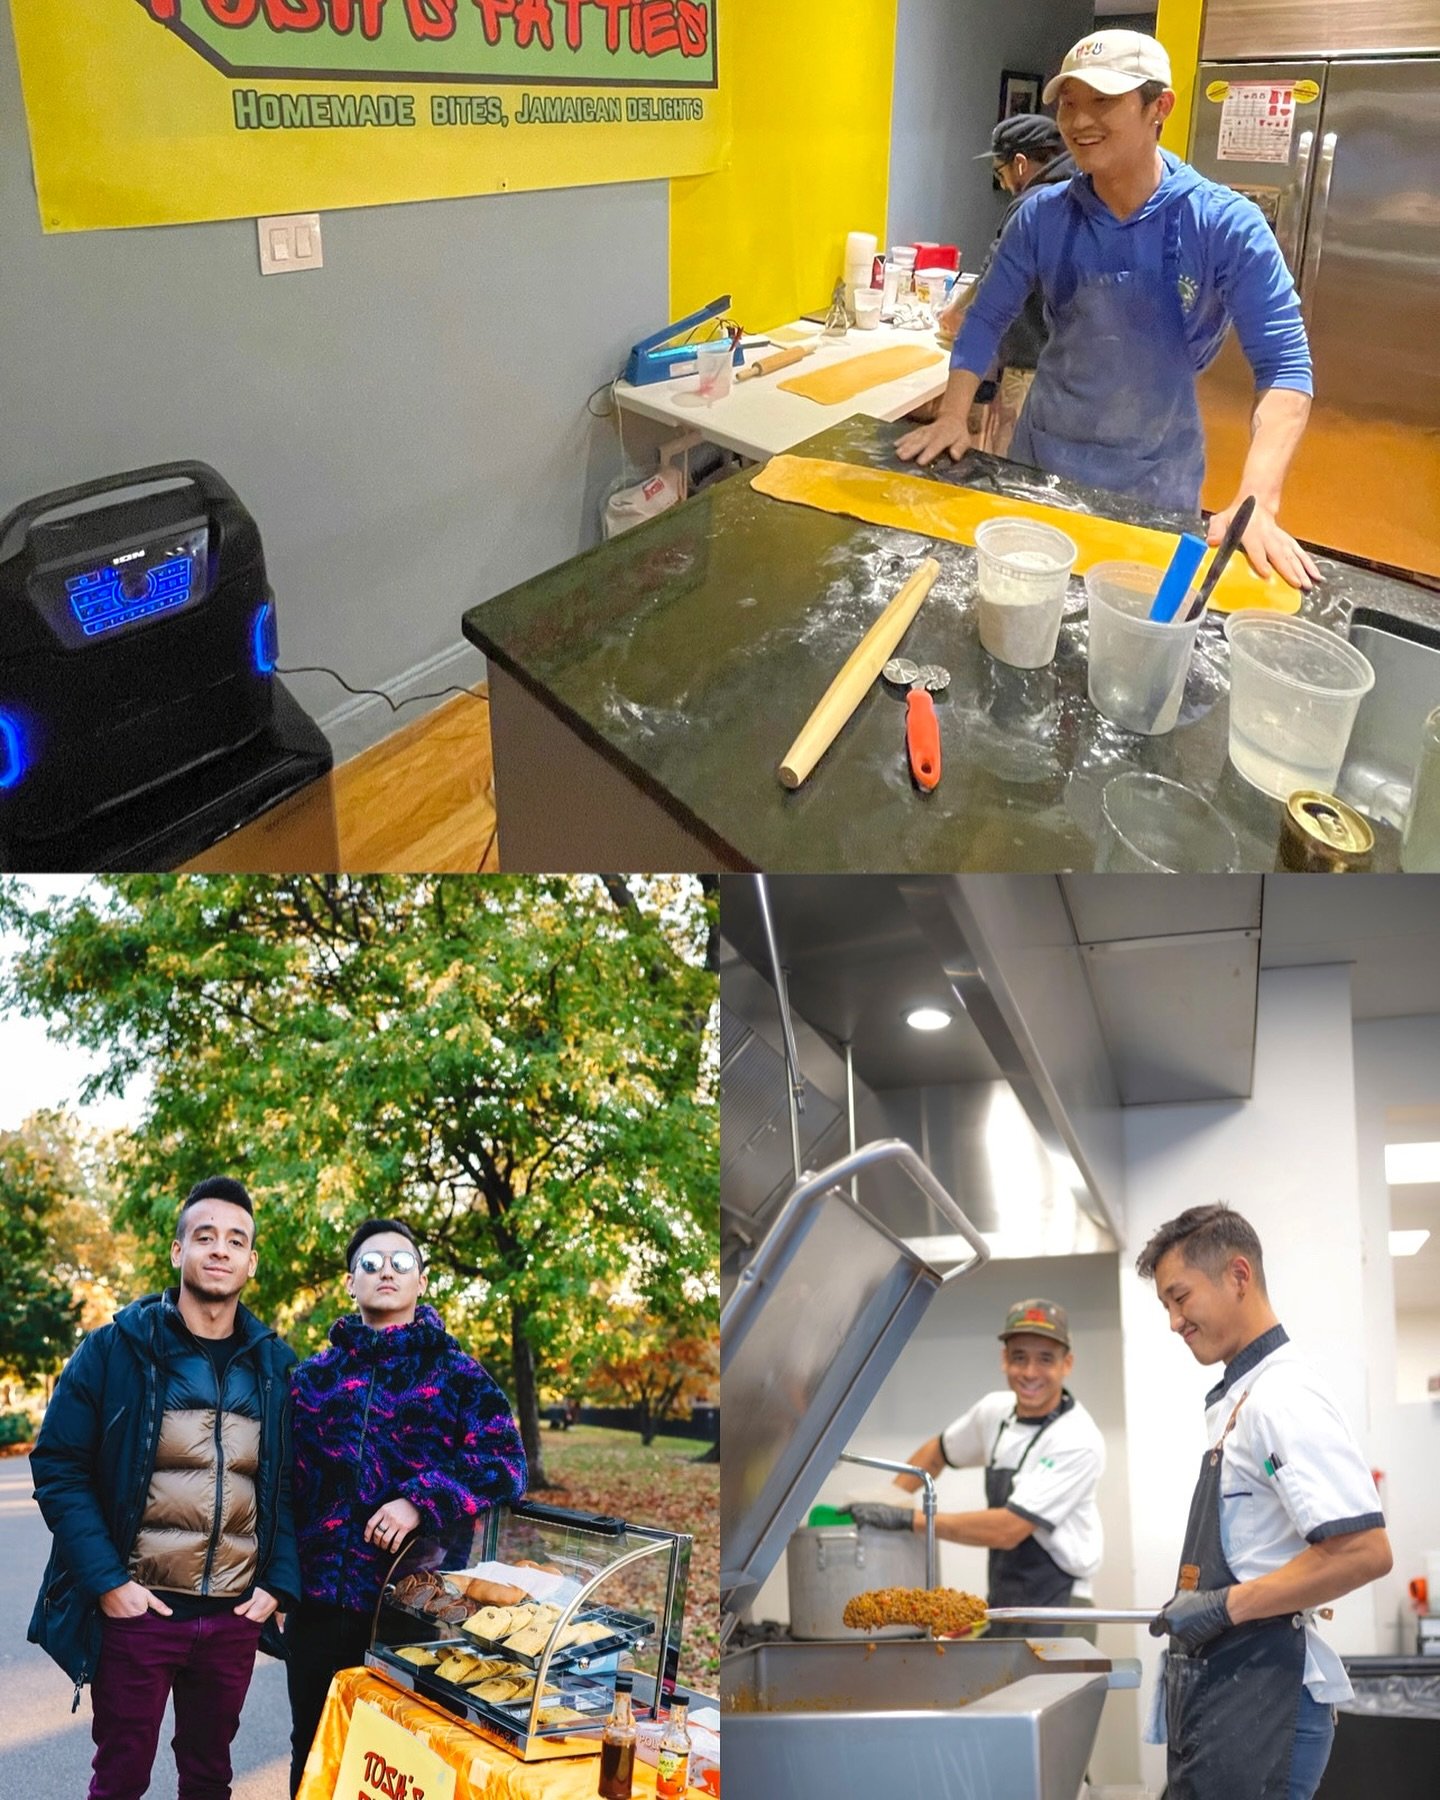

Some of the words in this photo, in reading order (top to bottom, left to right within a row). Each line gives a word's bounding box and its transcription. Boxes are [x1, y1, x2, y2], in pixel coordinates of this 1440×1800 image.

[478, 0, 707, 58] PATTIES
[233, 89, 415, 129] HOMEMADE
[431, 95, 508, 127] BITES,
[515, 93, 622, 124] JAMAICAN
[627, 97, 704, 122] DELIGHTS
